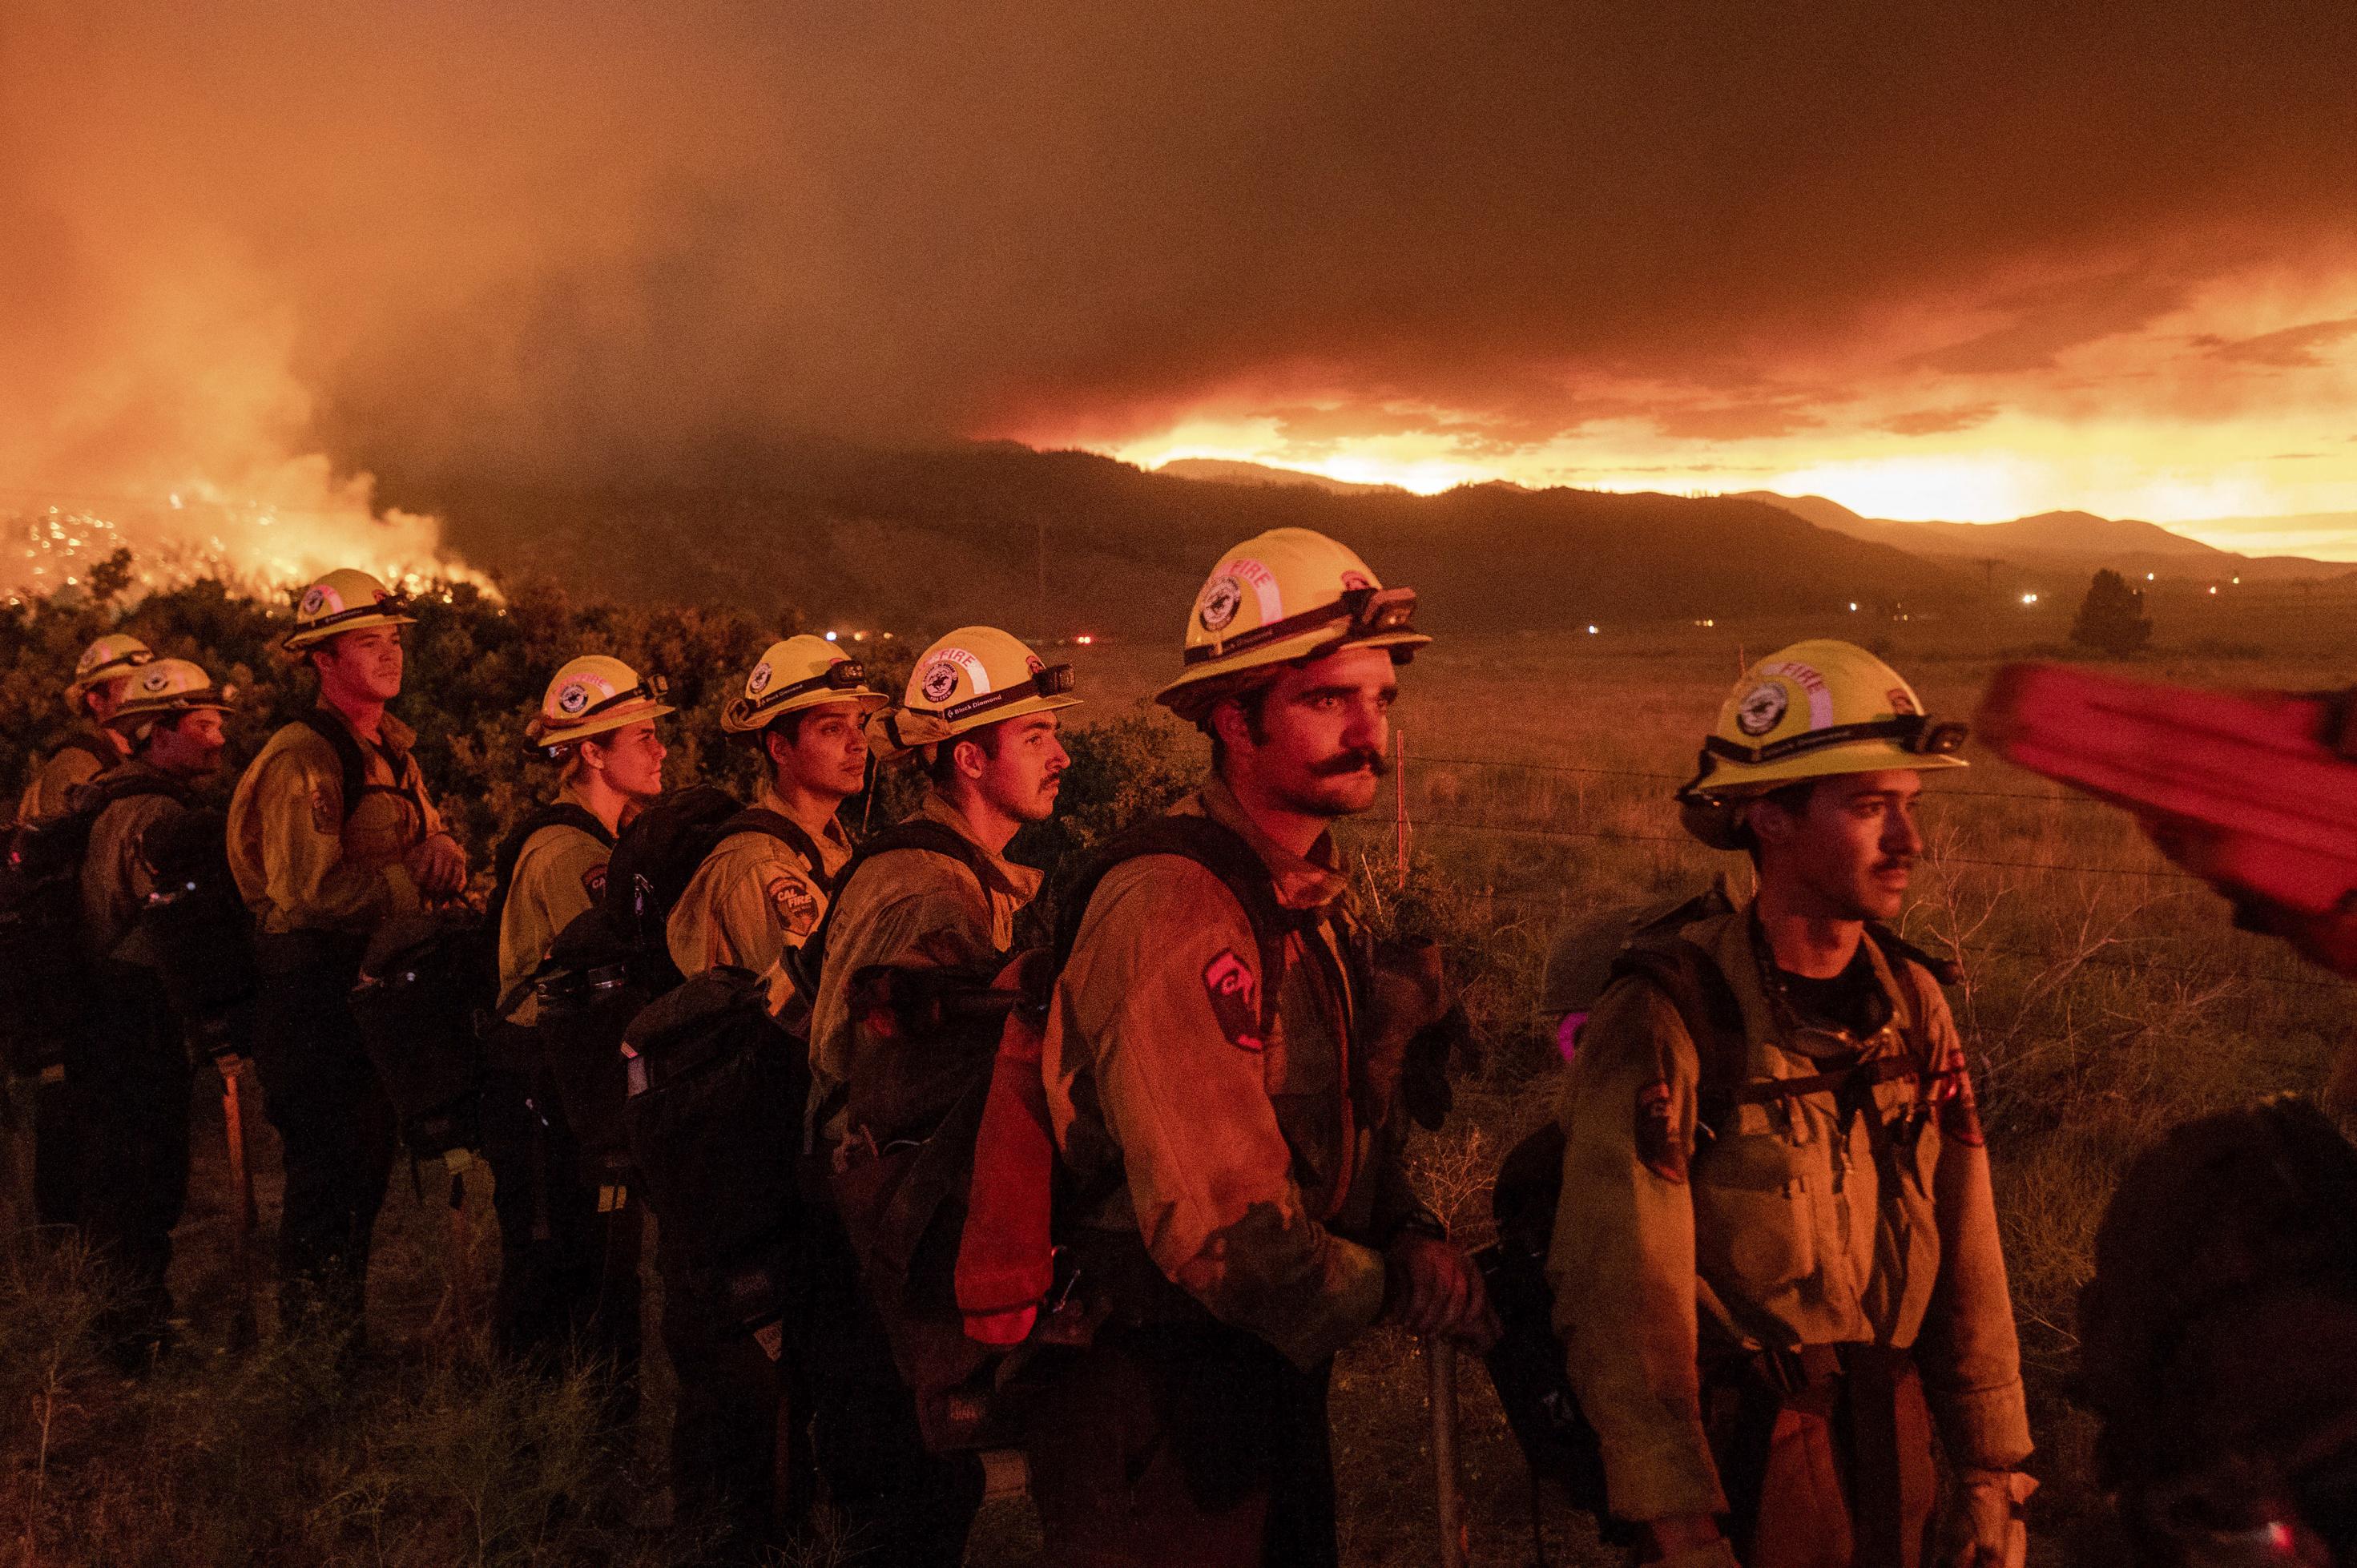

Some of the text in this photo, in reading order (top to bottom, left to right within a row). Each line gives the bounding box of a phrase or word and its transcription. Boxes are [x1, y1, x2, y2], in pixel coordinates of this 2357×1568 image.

[1230, 560, 1270, 589] FIRE
[939, 649, 975, 667] FIRE
[1780, 663, 1824, 695] FIRE
[954, 694, 1002, 715] Black Diamond
[592, 877, 606, 889] CA
[777, 889, 798, 901] CAL
[787, 894, 812, 909] FIRE
